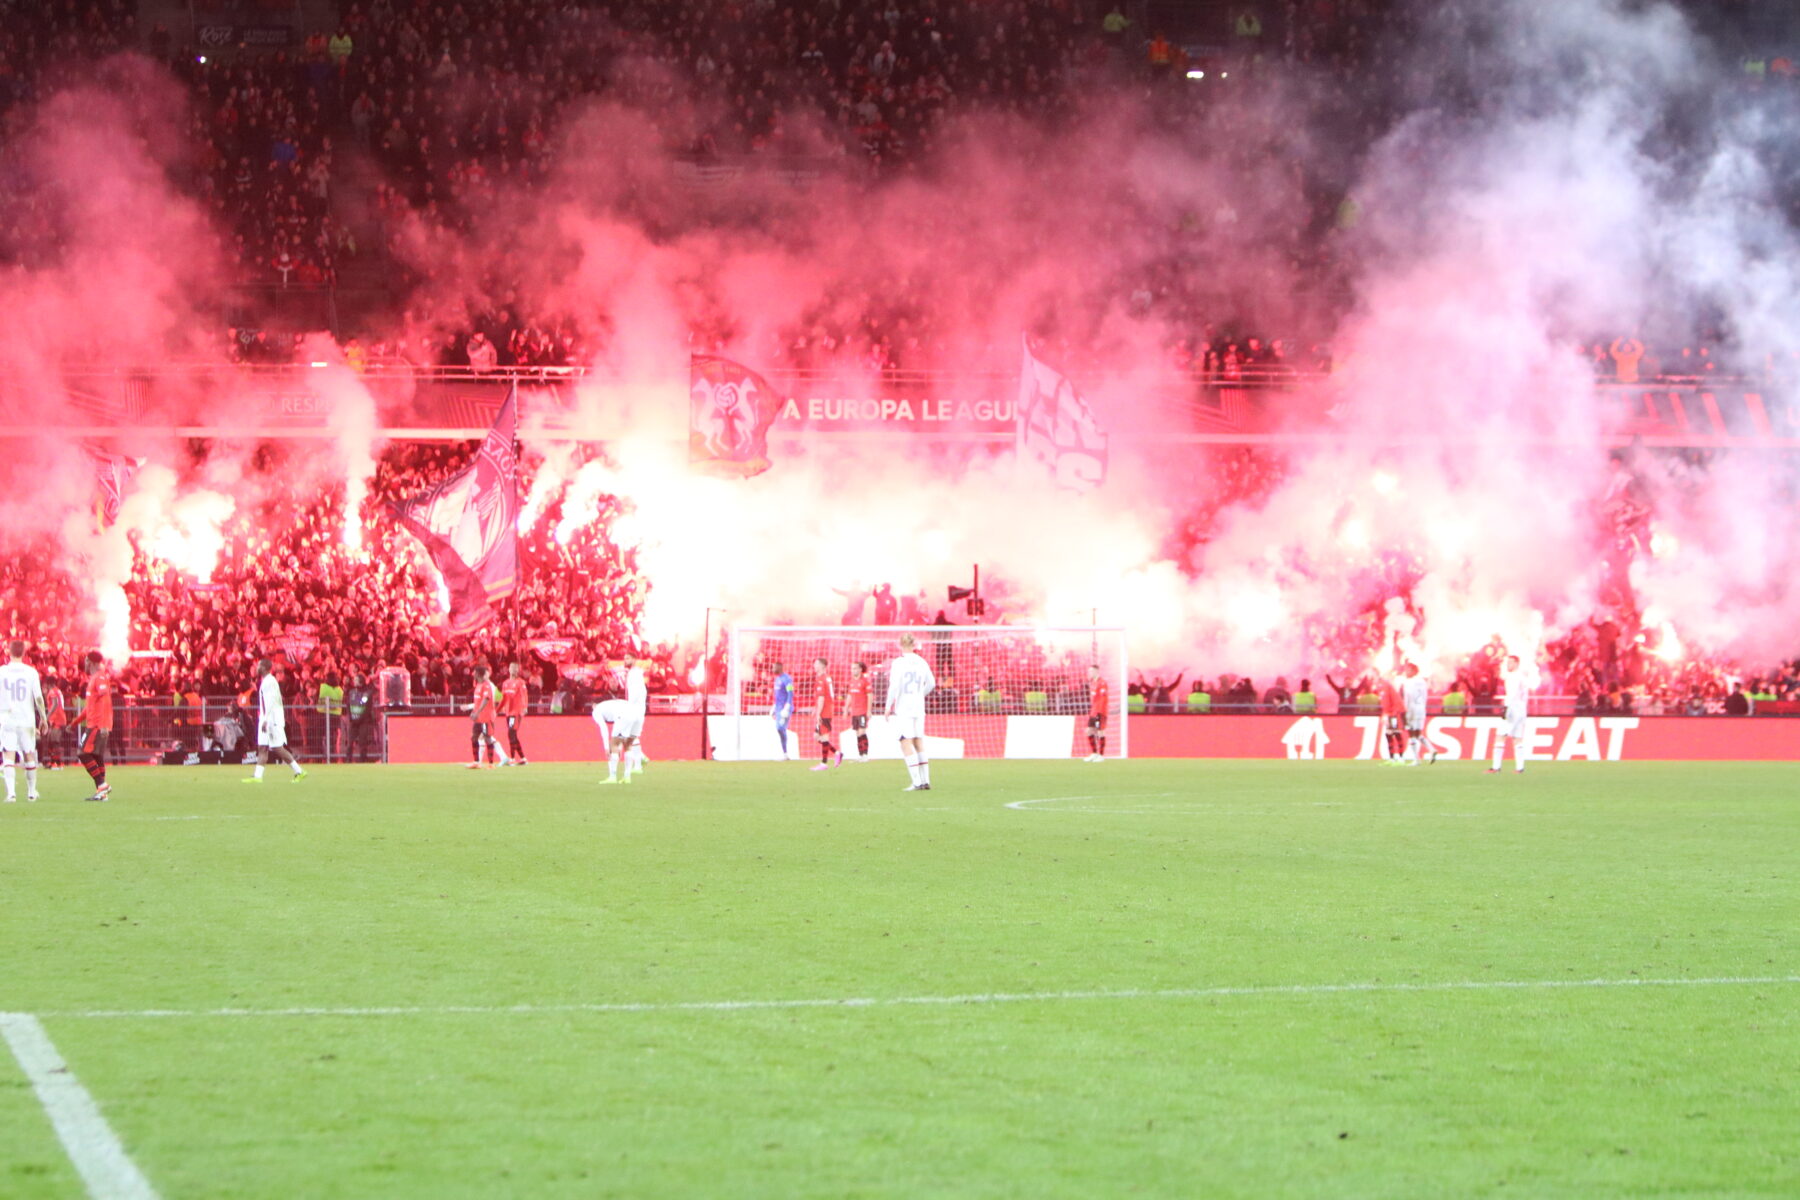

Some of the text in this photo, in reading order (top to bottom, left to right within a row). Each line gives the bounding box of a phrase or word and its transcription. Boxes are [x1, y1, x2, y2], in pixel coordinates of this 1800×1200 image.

[808, 399, 915, 420] EUROPA
[4, 678, 26, 702] 46
[904, 671, 921, 694] 24
[1523, 716, 1640, 760] EAT
